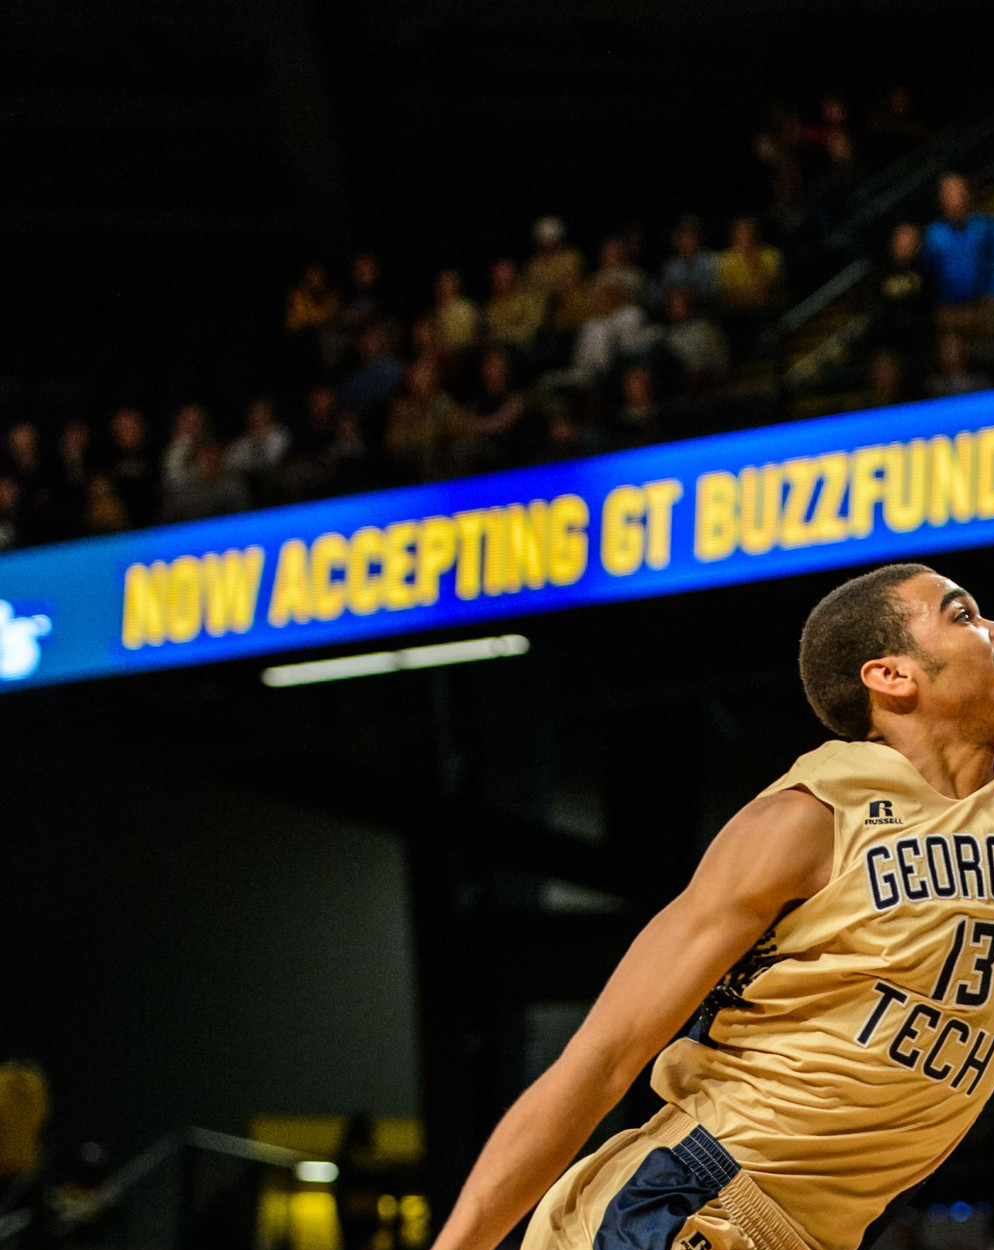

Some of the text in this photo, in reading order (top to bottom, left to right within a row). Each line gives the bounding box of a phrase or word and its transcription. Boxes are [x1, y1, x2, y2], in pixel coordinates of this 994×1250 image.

[121, 545, 265, 650] NOW
[268, 492, 590, 628] ACCEPTING
[600, 478, 684, 577] GT
